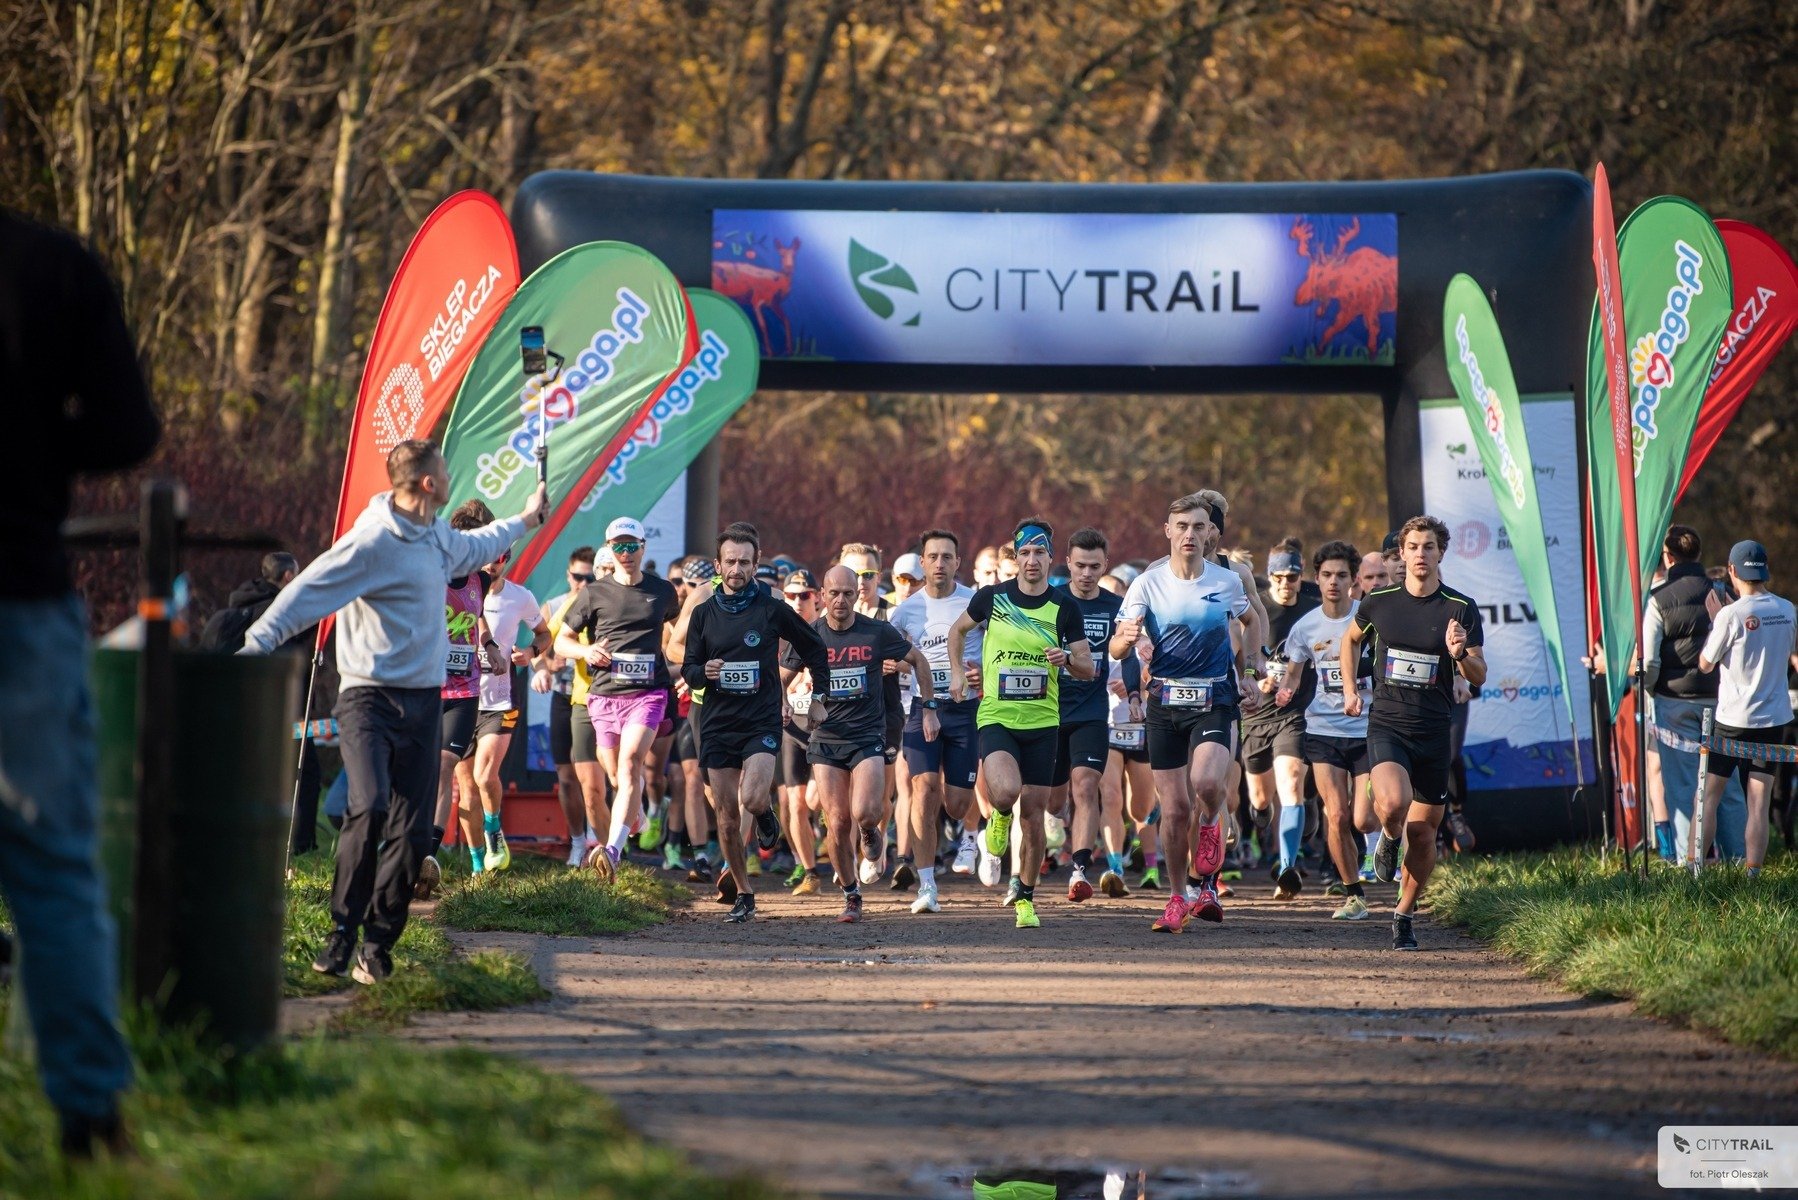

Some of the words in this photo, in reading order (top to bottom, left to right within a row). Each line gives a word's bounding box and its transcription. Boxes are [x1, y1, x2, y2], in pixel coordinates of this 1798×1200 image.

[420, 278, 467, 361] SKLEP
[428, 265, 502, 383] BIEGACZA
[619, 663, 648, 673] 1024
[1406, 663, 1416, 675] 4
[724, 672, 750, 683] 595
[1015, 677, 1032, 688] 10
[830, 678, 859, 690] 1120
[1176, 689, 1199, 700] 331
[1115, 731, 1134, 741] 613
